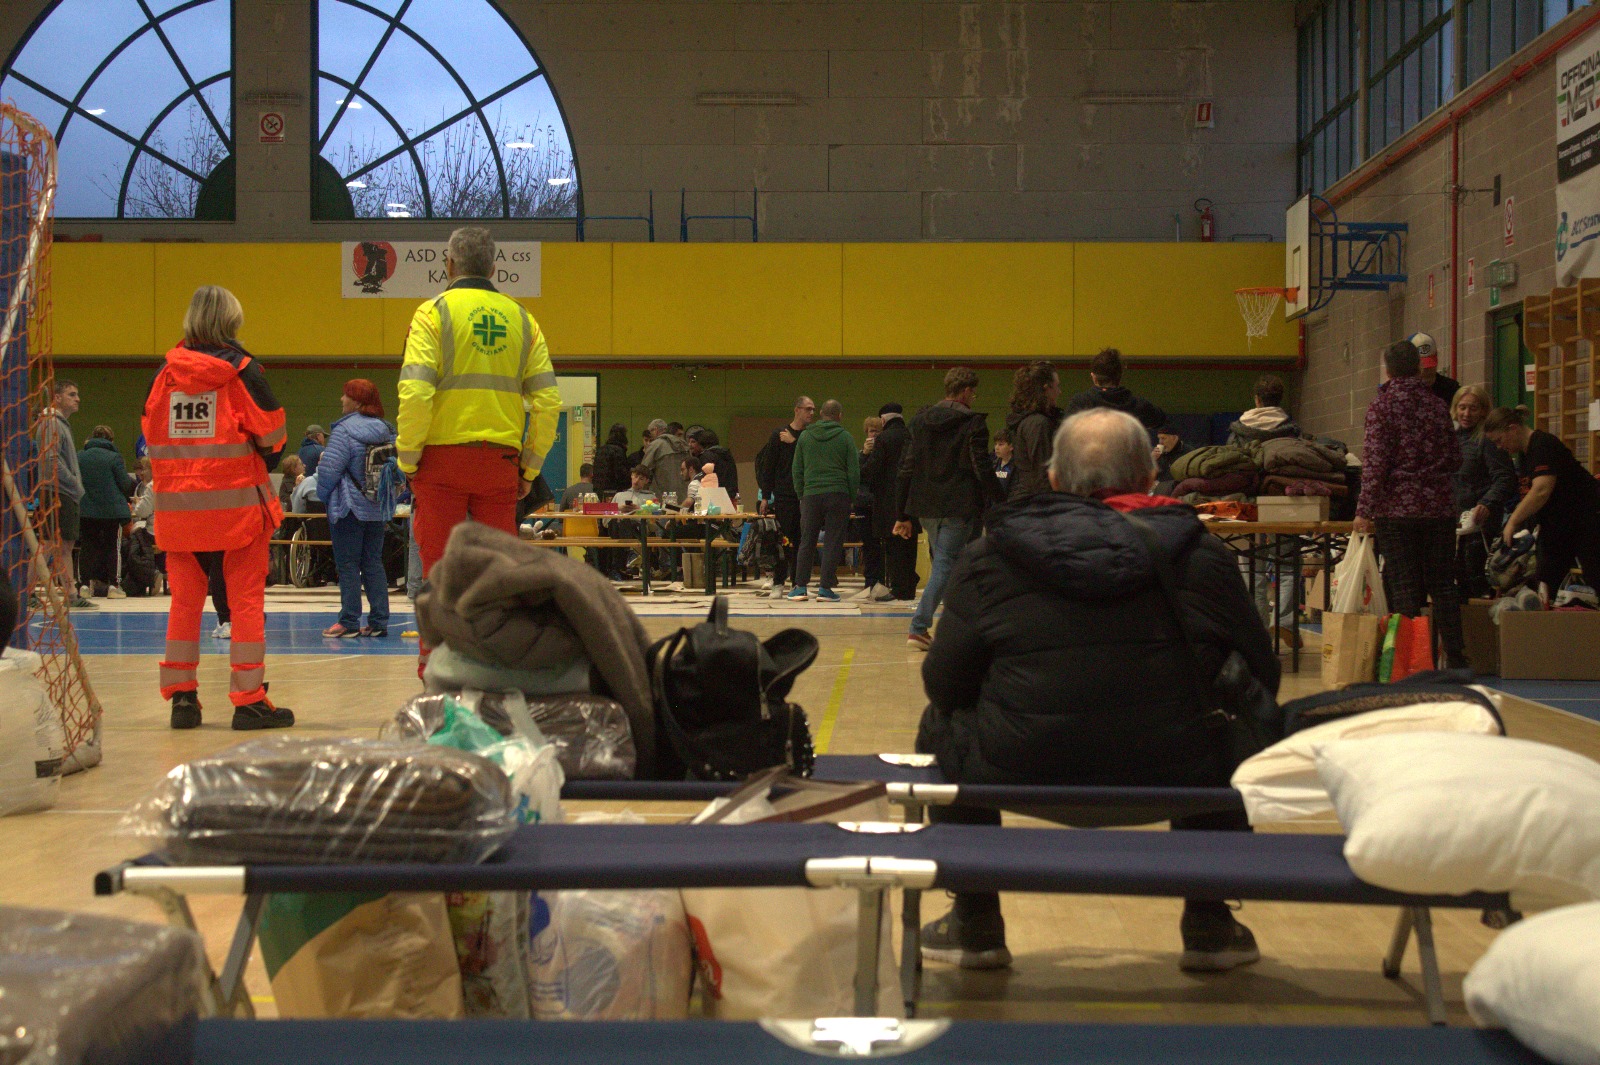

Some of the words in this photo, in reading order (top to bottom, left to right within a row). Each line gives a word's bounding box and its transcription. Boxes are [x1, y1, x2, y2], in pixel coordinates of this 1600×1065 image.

[405, 249, 436, 262] ASD
[497, 269, 519, 283] Do
[467, 306, 485, 321] CROCE
[490, 307, 510, 323] VERDE
[173, 402, 208, 419] 118
